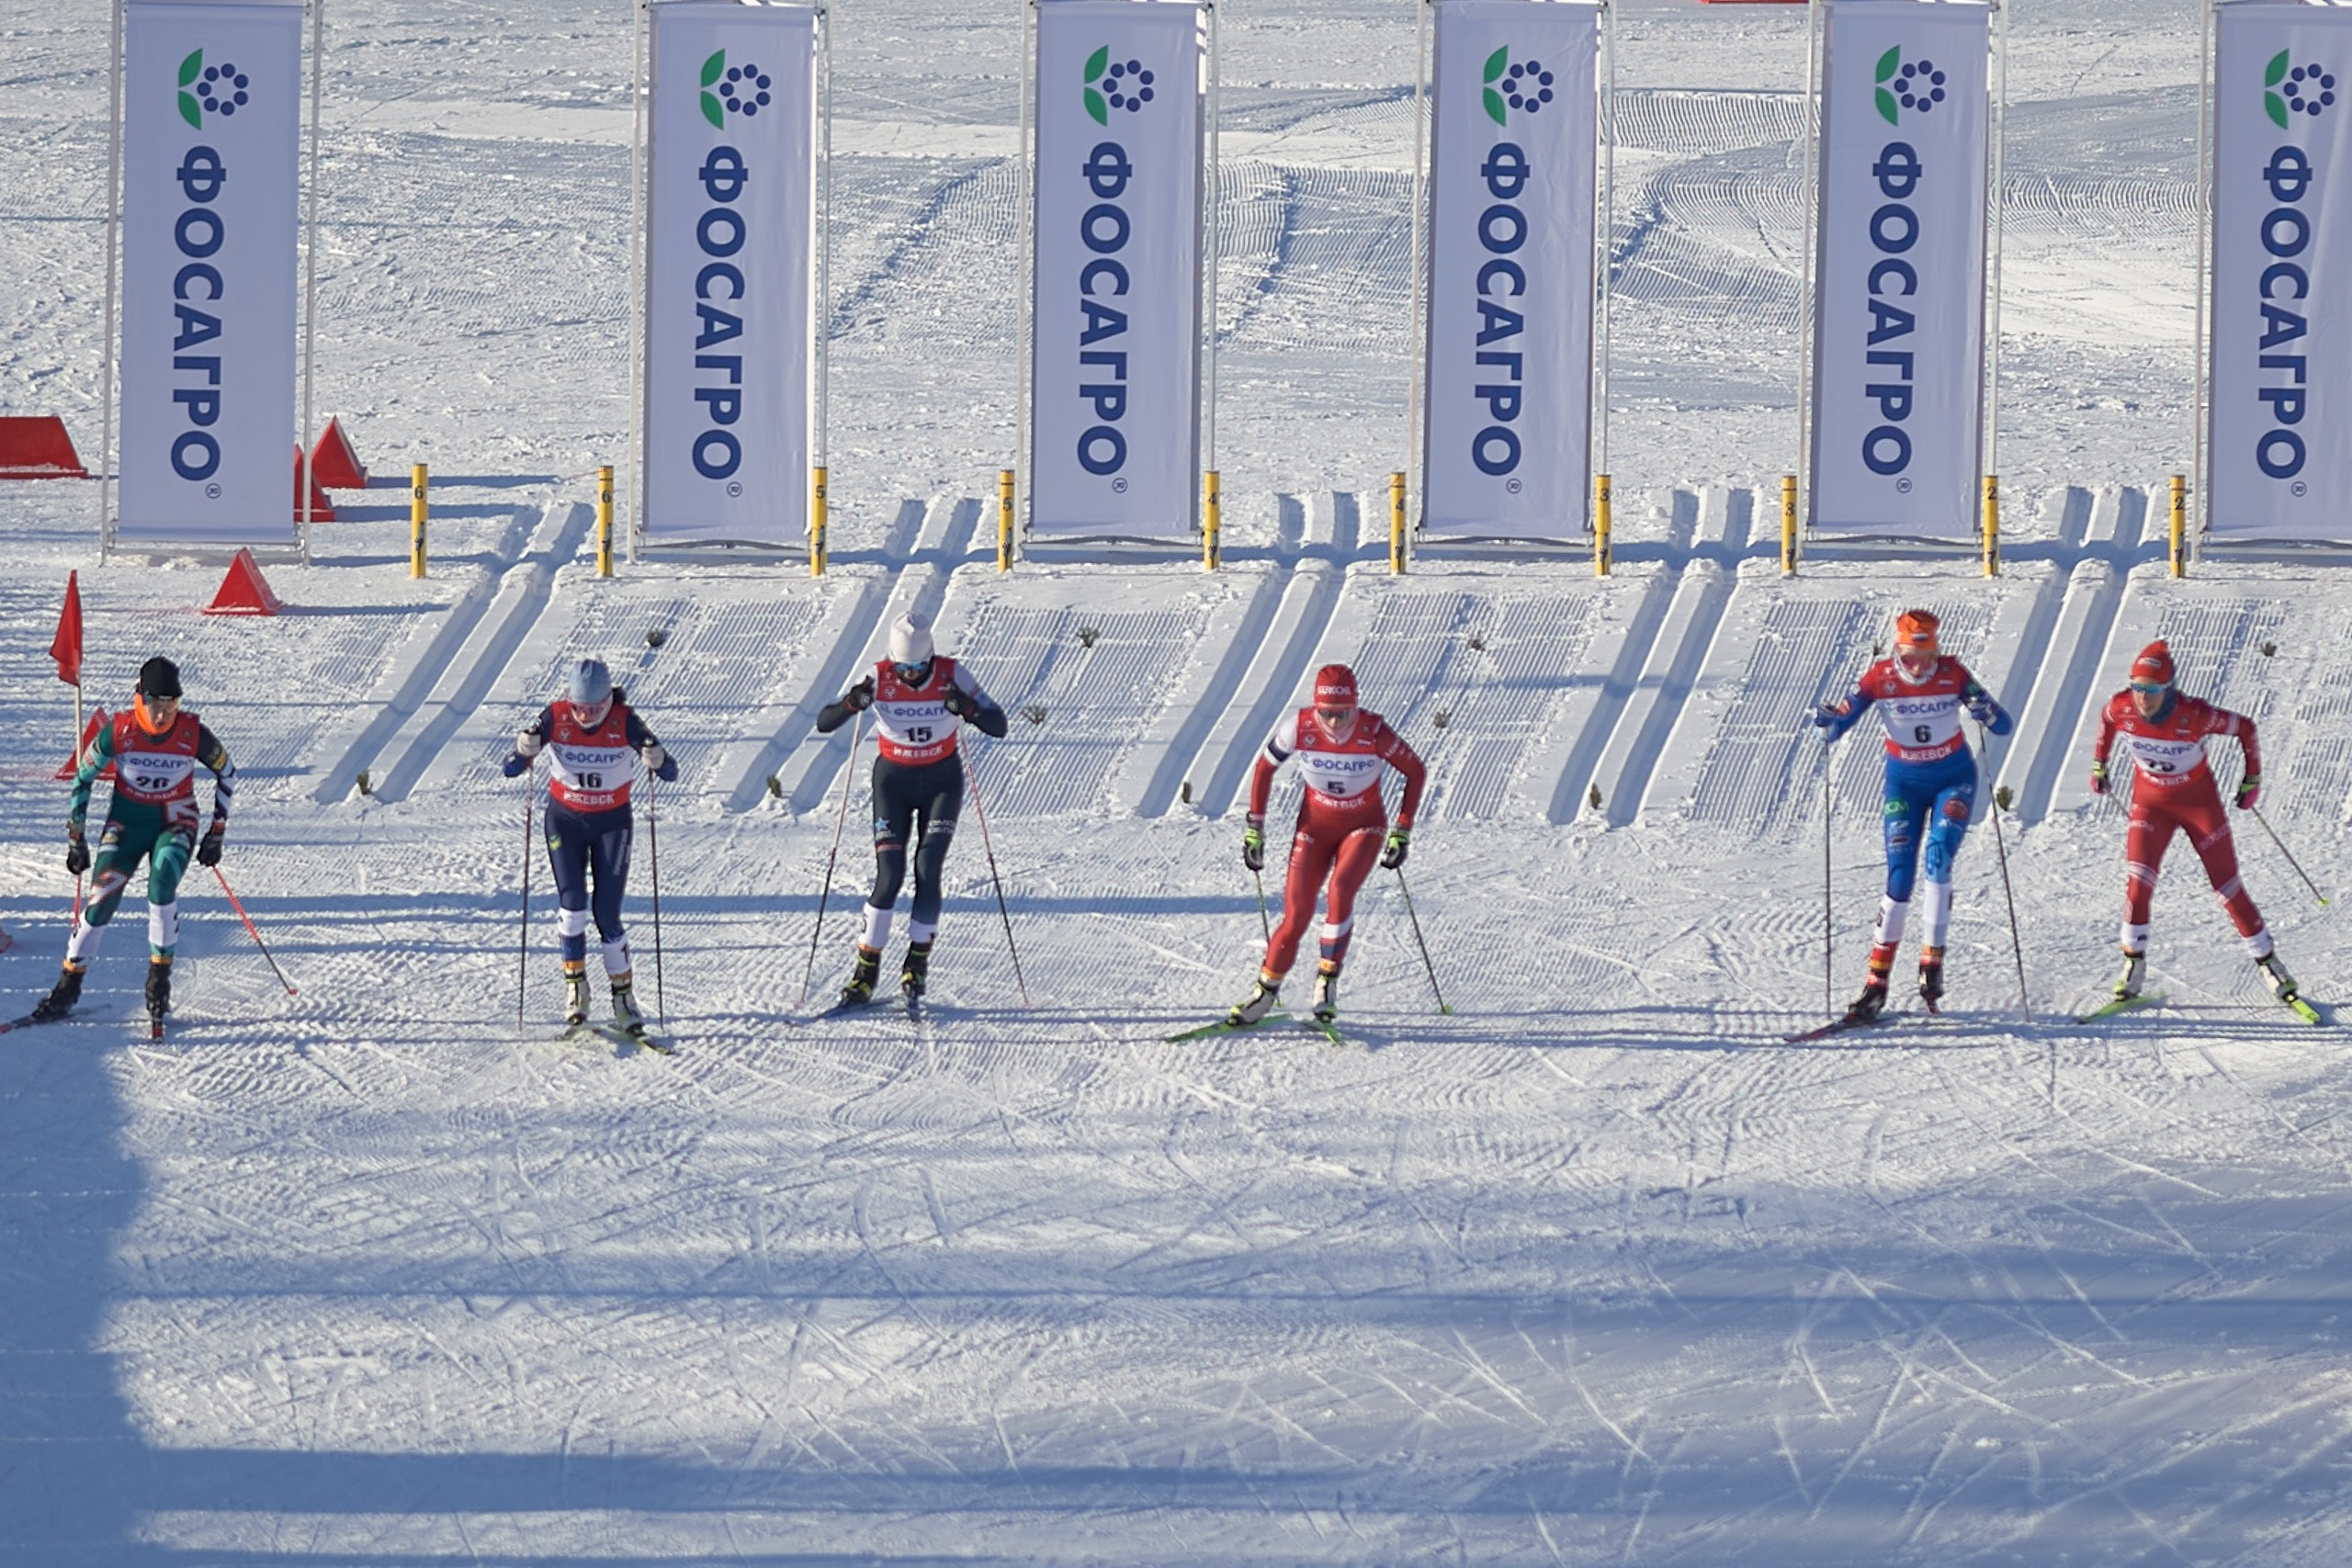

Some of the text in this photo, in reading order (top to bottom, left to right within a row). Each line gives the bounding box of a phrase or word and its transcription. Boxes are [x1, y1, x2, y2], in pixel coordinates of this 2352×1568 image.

[171, 146, 226, 481] ФОСАГРО
[693, 146, 748, 479] ФОСАГРО
[1078, 142, 1132, 475] ФОСАГРО
[1473, 143, 1530, 476] ФОСАГРО
[1862, 142, 1922, 475] ФОСАГРО
[2256, 146, 2312, 479] ФОСАГРО
[414, 485, 424, 499] 6
[602, 491, 612, 504] 6
[816, 485, 826, 499] 5
[1208, 491, 1217, 506] 4
[1600, 487, 1610, 502] 3
[1987, 486, 1996, 501] 2
[1003, 497, 1012, 512] 5
[1396, 497, 1405, 512] 4
[1786, 502, 1795, 516] 3
[2175, 496, 2185, 510] 2
[904, 726, 933, 742] 15
[1915, 724, 1931, 743] 6
[130, 757, 190, 769] ФОСАГР
[1312, 759, 1375, 771] ФОСАГРО
[573, 772, 603, 788] 16
[1328, 781, 1346, 795] 5
